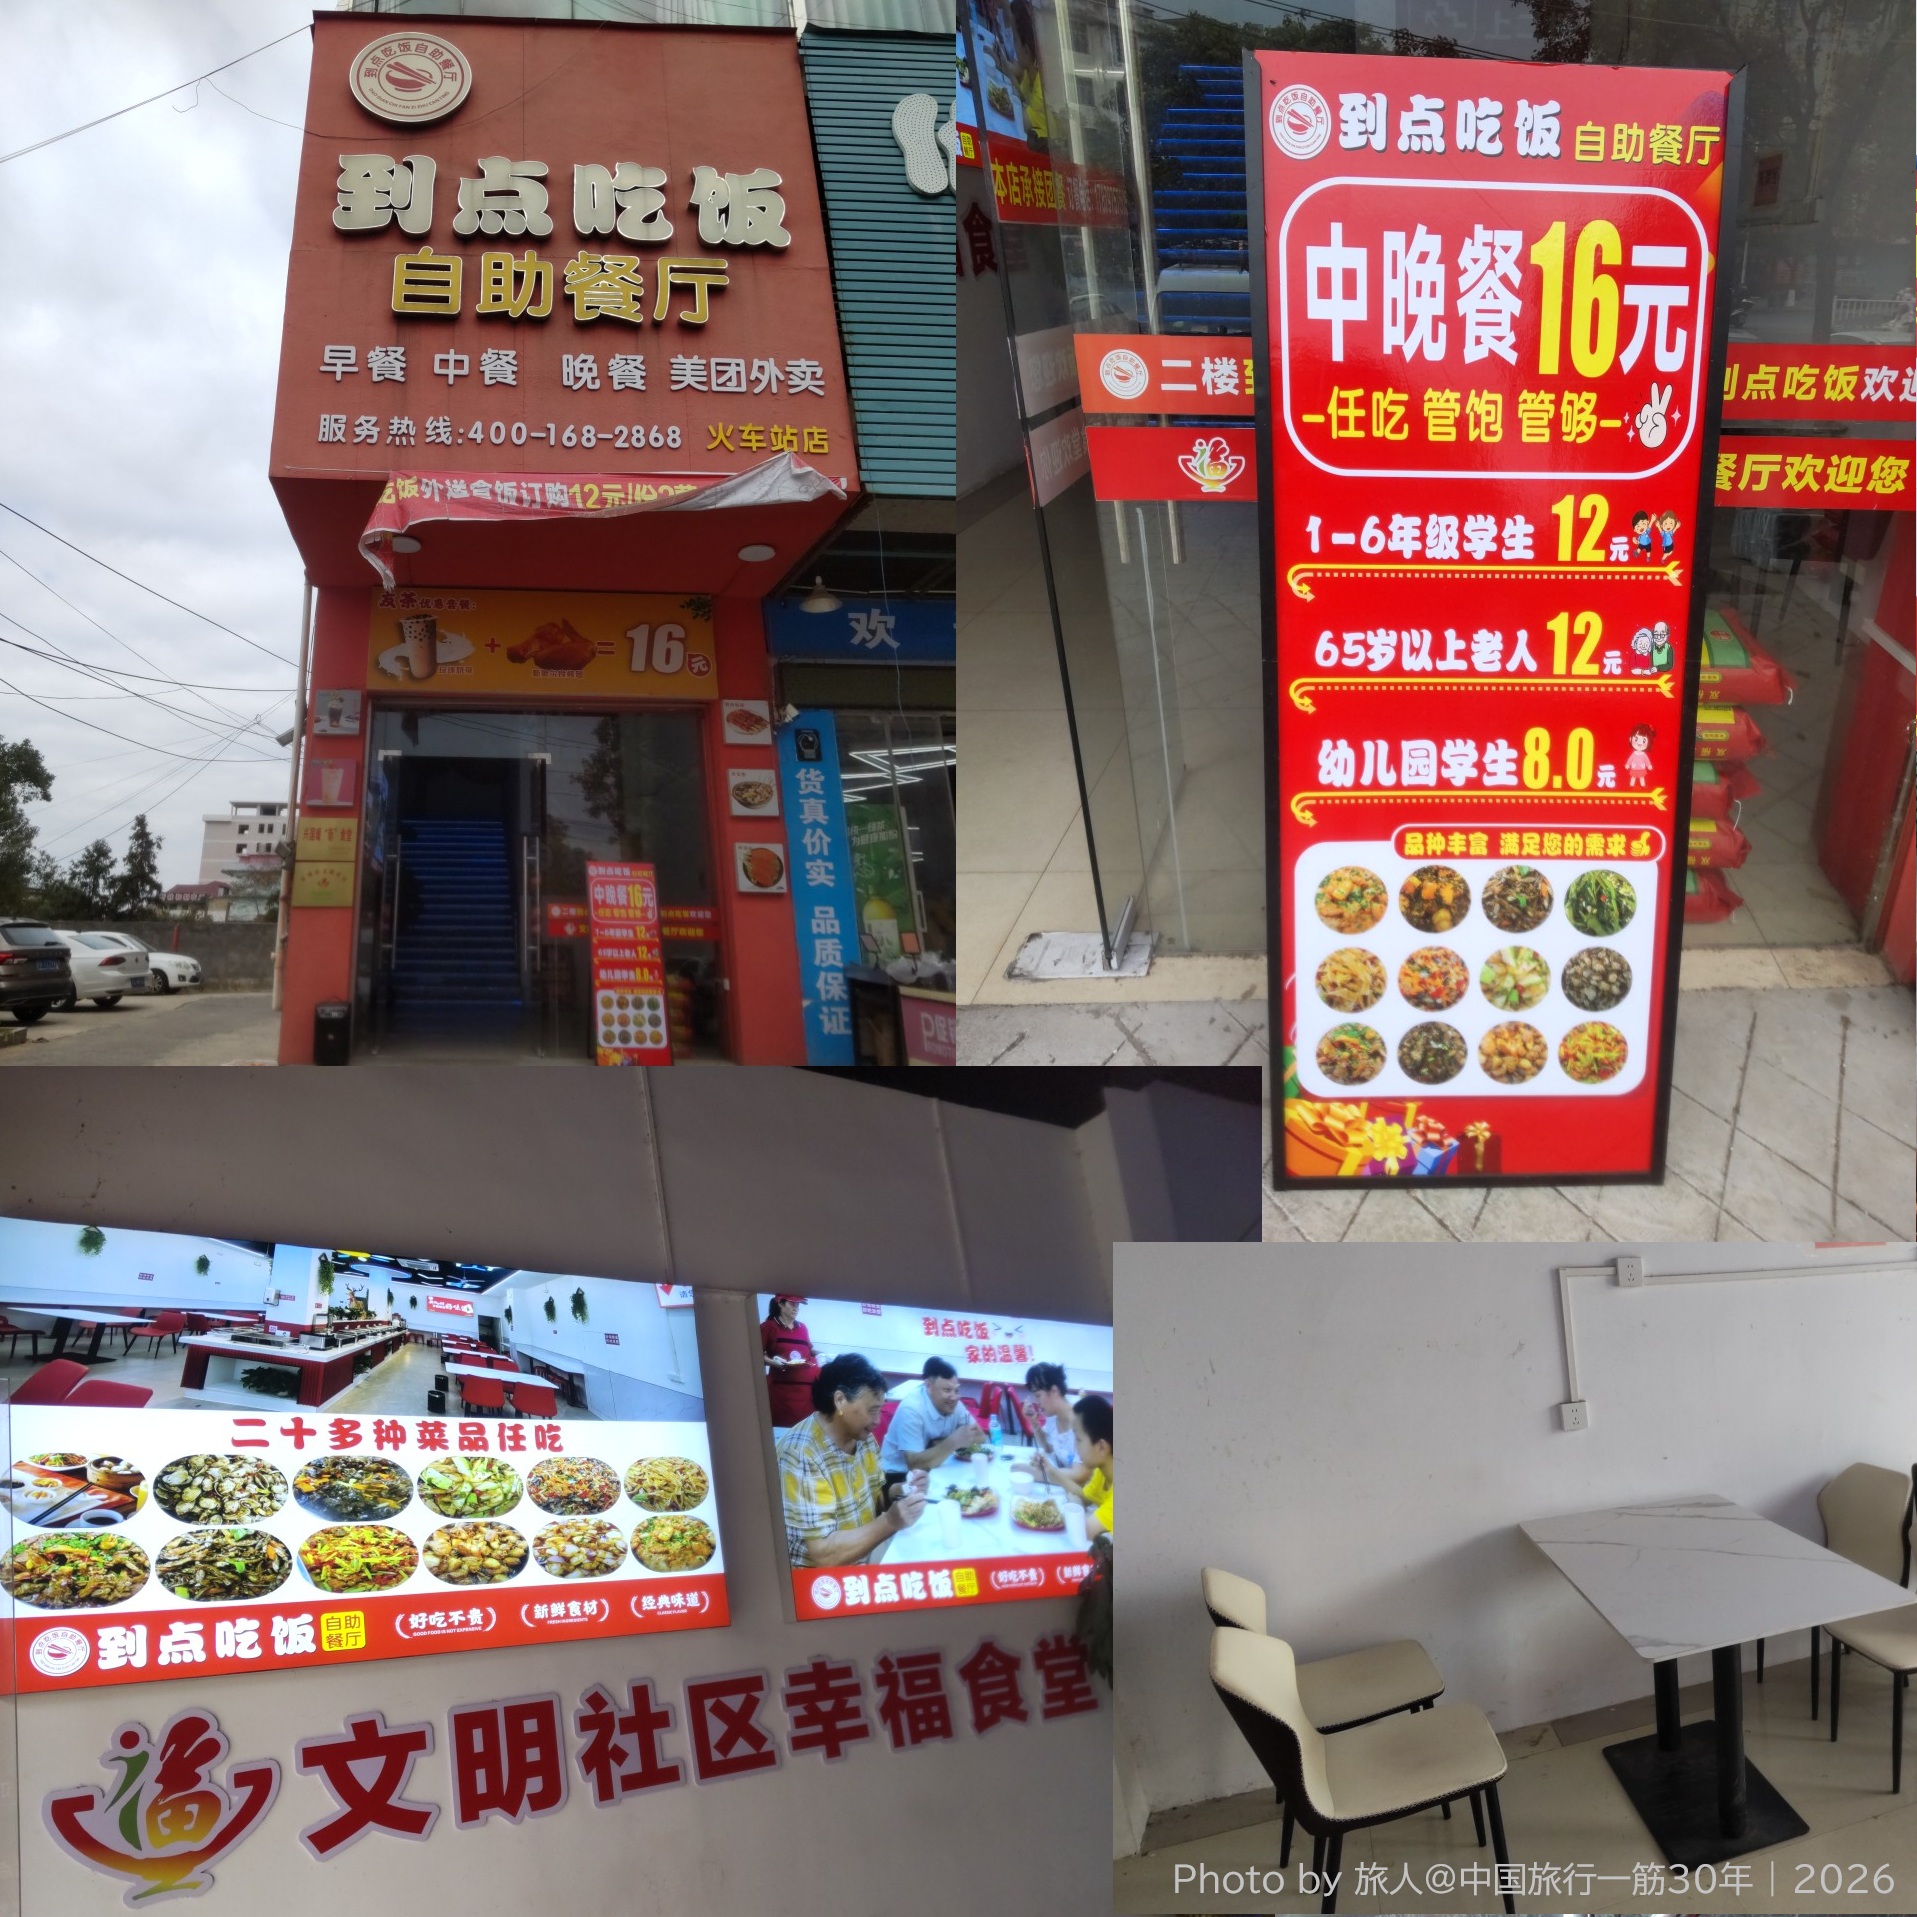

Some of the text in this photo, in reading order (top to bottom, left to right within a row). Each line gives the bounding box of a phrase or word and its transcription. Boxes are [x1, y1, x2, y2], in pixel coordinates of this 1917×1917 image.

[364, 42, 457, 81] 到点吃饭自助餐厅
[1338, 92, 1562, 157] 到点吃饭
[1574, 121, 1721, 166] 自助餐厅
[332, 153, 791, 249] 到点吃饭
[391, 246, 730, 326] 自助餐厅
[320, 344, 825, 396] 早餐 中餐 晚餐 美团外卖
[1423, 387, 1503, 443] 管饱
[707, 421, 830, 455] 火车站店
[1716, 453, 1910, 494] 餐厅欢迎您
[1306, 514, 1534, 560] 1-6年级学生
[626, 624, 710, 674] 16 元
[848, 608, 900, 650] 欢
[1315, 627, 1537, 672] 65岁以上老人
[1317, 738, 1519, 787] 幼儿园学生
[1405, 832, 1627, 857] 品种丰富 满足您的需求
[795, 768, 852, 1036] 货真价实 品质保证
[922, 1316, 990, 1340] 到点吃饭
[231, 1416, 564, 1453] 二十多种菜品任吃
[642, 1591, 701, 1611] 经典味道
[842, 1569, 953, 1606] 到点吃饭
[326, 1614, 361, 1631] 自助
[409, 1607, 484, 1630] 好吃不贵
[534, 1600, 598, 1619] 新鲜食材
[97, 1613, 317, 1670] 到点吃饭
[326, 1632, 362, 1650] 餐厅
[301, 1634, 1099, 1854] 文明社区幸福食堂
